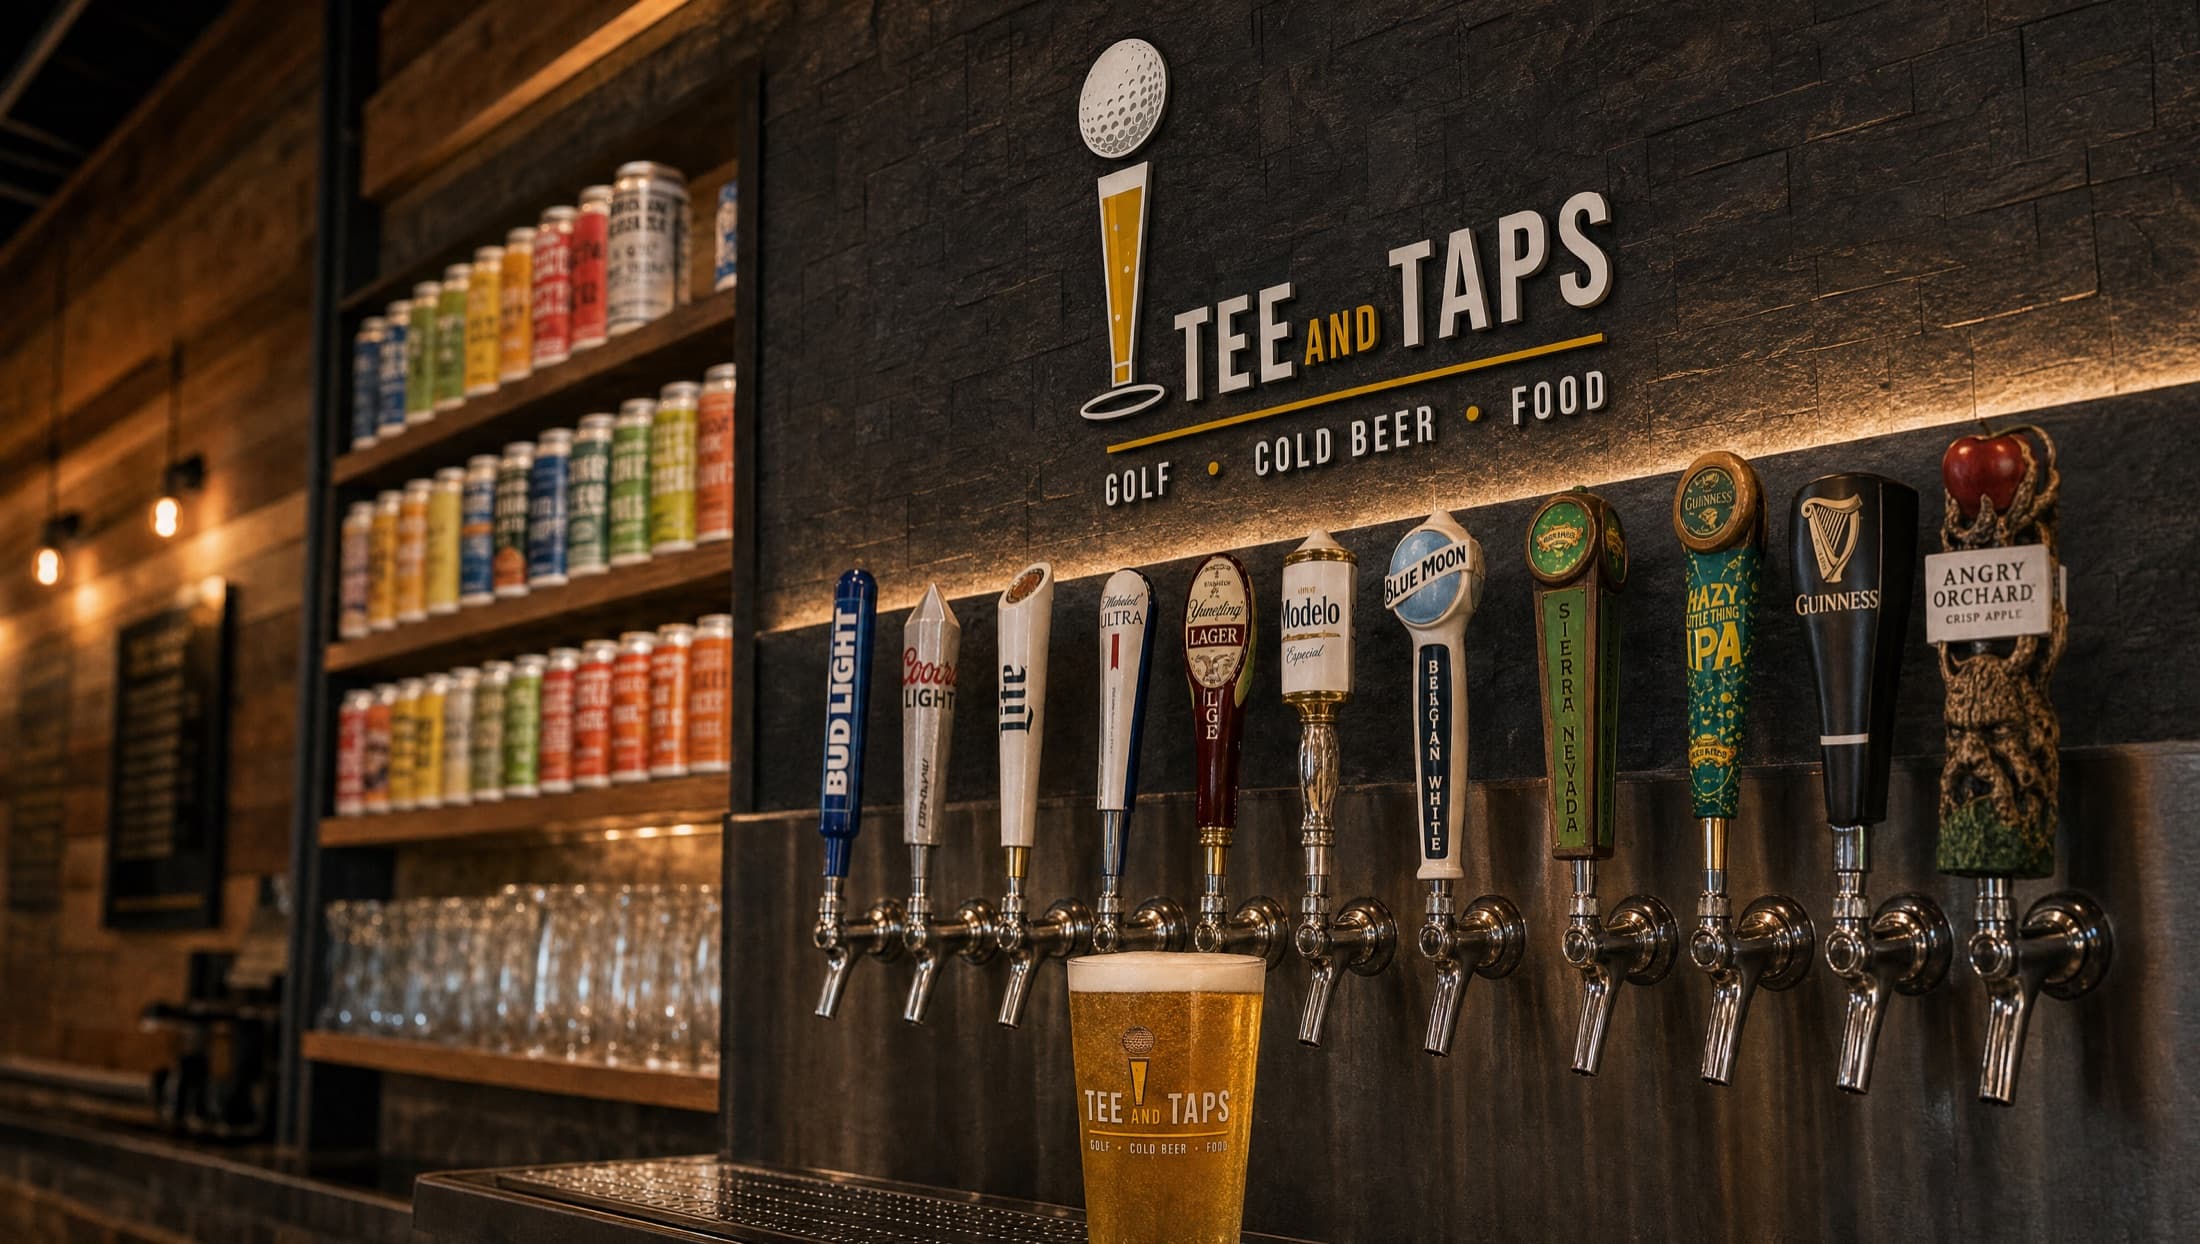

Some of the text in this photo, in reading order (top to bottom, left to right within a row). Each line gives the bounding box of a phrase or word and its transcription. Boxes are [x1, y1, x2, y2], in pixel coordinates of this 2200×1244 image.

[1174, 191, 1611, 401] TEE AND TAPS
[1105, 370, 1605, 507] GOLF COLD BEER FOOD
[1385, 544, 1466, 606] BLUE MOON
[1943, 561, 2025, 586] ANGRY
[1687, 583, 1738, 613] HAZY
[1796, 590, 1879, 616] GUINNESS
[1933, 584, 2033, 608] ORCHARD
[1101, 610, 1143, 628] ULTRA
[1281, 595, 1340, 631] Modelo
[1710, 605, 1739, 624] THING
[1946, 609, 2023, 625] CRISP APPLE
[1190, 627, 1238, 646] LAGER
[1686, 621, 1742, 671] IPA
[1559, 603, 1575, 713] SIERRA
[825, 607, 857, 796] BUD LIGHT
[905, 688, 955, 711] LIGHT
[1562, 726, 1578, 833] NEVADA
[1428, 776, 1442, 851] WHITE
[1085, 1089, 1230, 1125] TEE AND TAPS
[1090, 1139, 1110, 1152] GOLF
[1130, 1143, 1155, 1154] COLD
[1161, 1143, 1186, 1154] BEER
